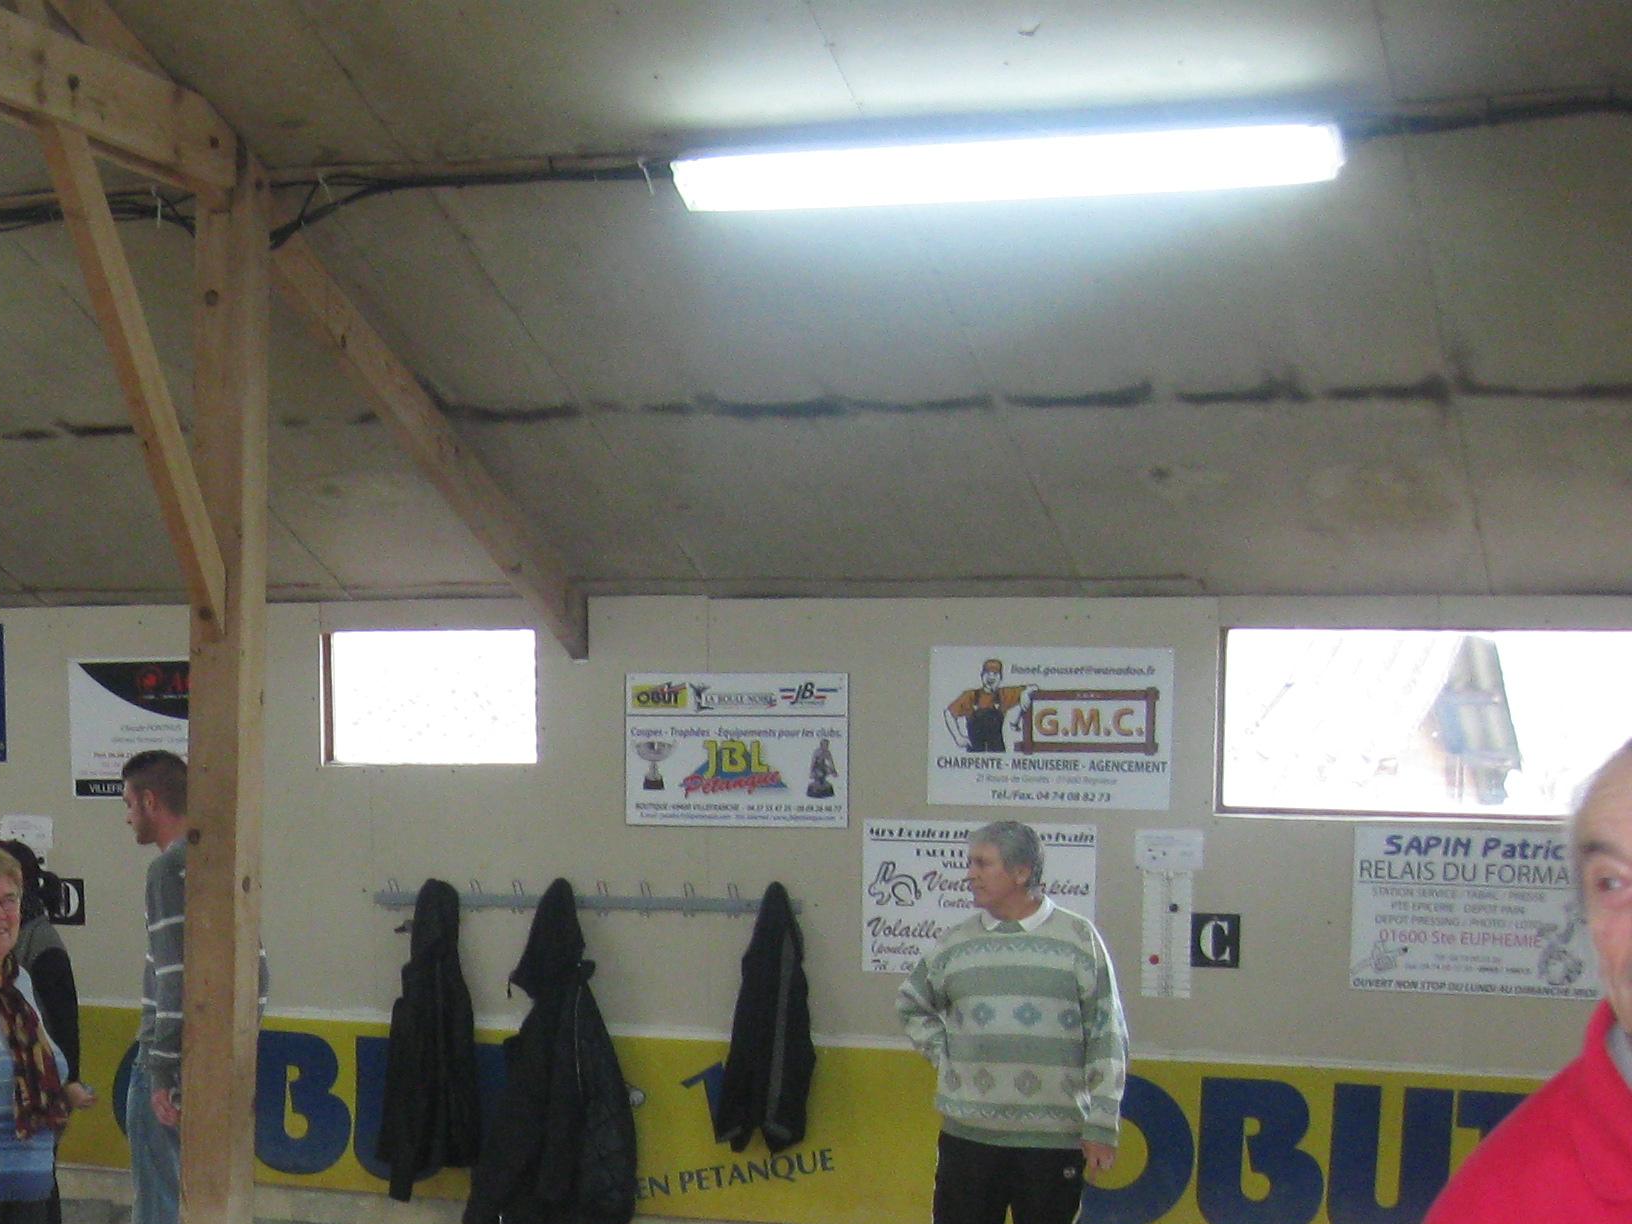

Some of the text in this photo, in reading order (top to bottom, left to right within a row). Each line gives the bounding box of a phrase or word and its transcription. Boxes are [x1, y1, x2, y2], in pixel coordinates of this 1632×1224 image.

[1034, 707, 1144, 736] G.M.C.
[703, 740, 770, 778] JBL
[937, 756, 1167, 774] CHARPENTE MENUISERIE AGENCEMENT
[88, 783, 125, 794] VILLEFR
[1036, 791, 1050, 801] 04
[1052, 791, 1065, 801] 74
[1384, 835, 1567, 860] SAPIN Patric
[1359, 860, 1570, 885] RELAIS DU FORMA
[1417, 888, 1457, 898] SERVICE
[867, 917, 942, 939] Volaille
[1411, 916, 1460, 926] PRESSING
[1200, 920, 1230, 961] C
[1380, 929, 1543, 949] 01600 Ste EUPHEMIE
[1353, 977, 1393, 988] OUVERT
[1395, 979, 1418, 990] NON
[1419, 980, 1446, 991] STOP
[1448, 982, 1464, 992] DU
[1464, 982, 1496, 993] LUNDI
[1514, 985, 1569, 996] DIMANCHE
[679, 1148, 835, 1193] PETANQUE
